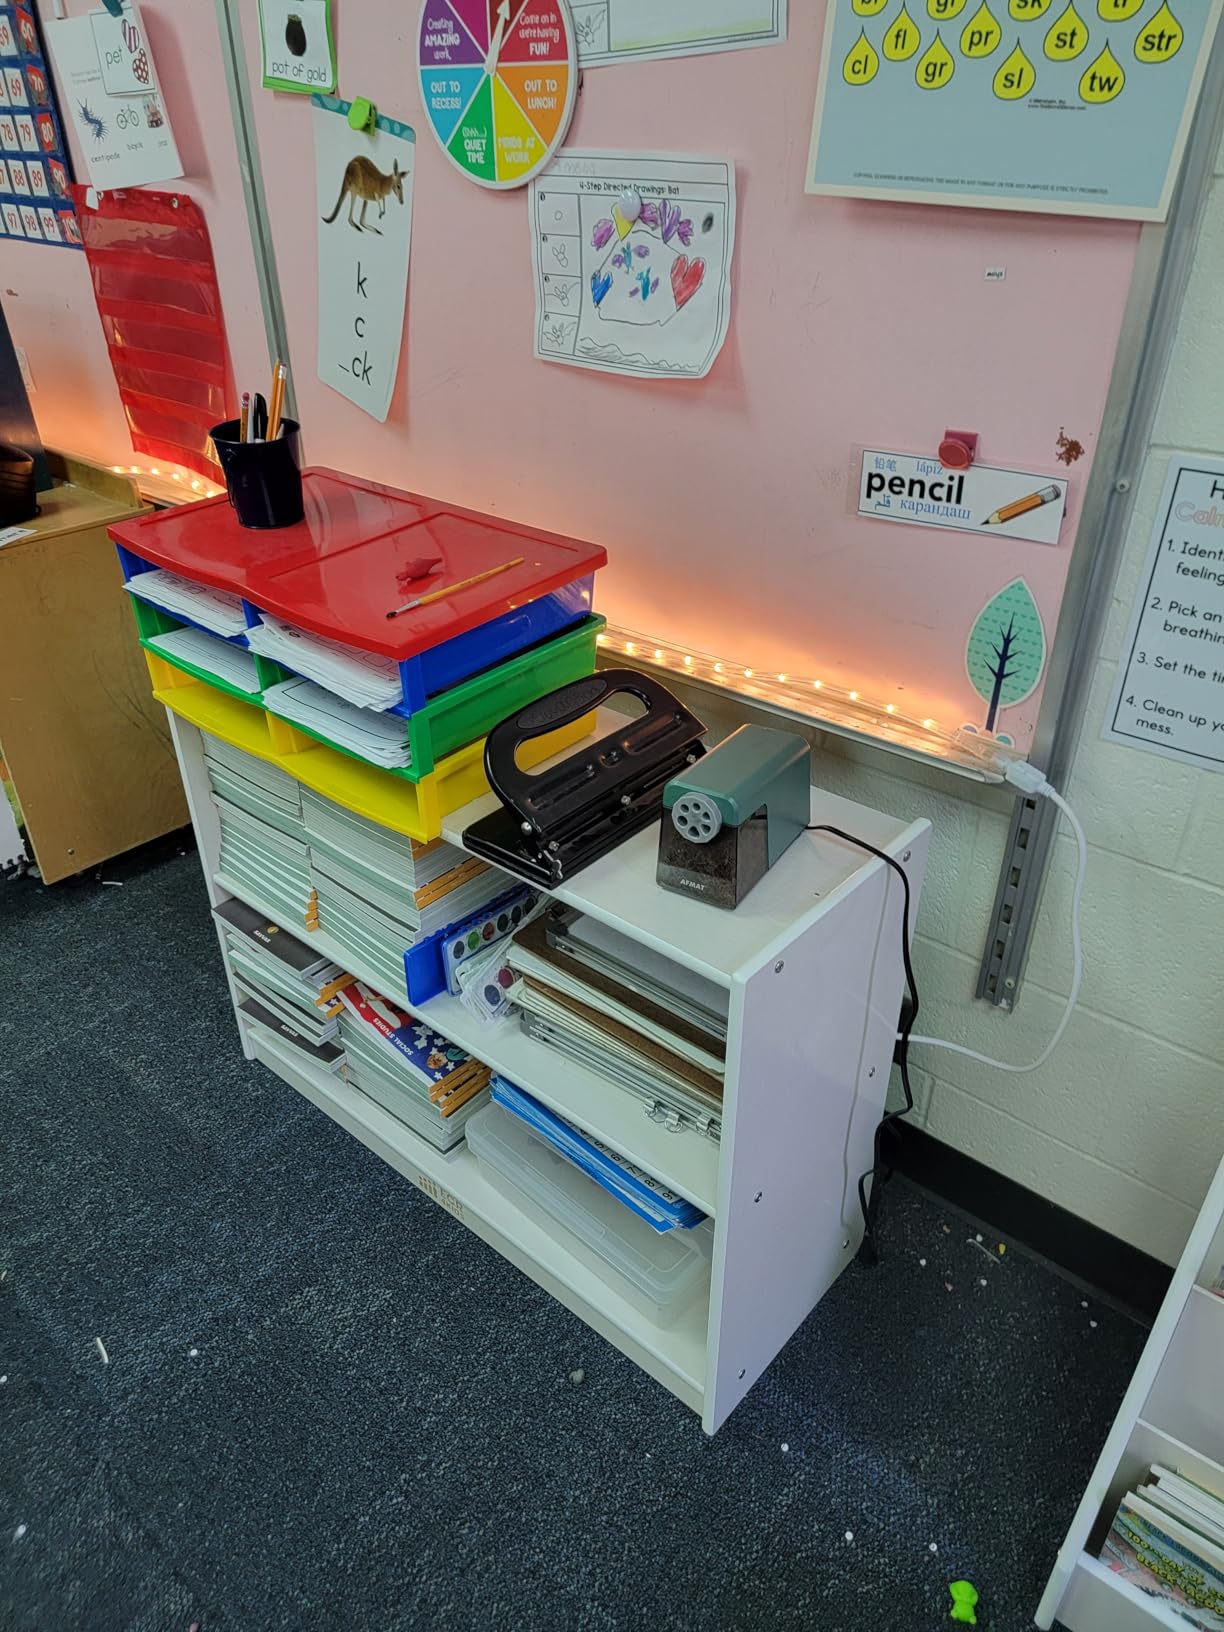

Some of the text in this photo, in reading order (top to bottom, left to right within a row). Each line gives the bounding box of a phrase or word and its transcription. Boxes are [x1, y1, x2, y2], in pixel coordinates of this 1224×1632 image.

[427, 18, 454, 33] Creating
[520, 12, 557, 25] Come on in
[424, 33, 460, 47] AMAZING
[537, 26, 559, 43] having
[894, 29, 907, 50] fl
[968, 30, 994, 52] pr
[1055, 27, 1078, 49] st
[1142, 29, 1177, 52] str
[106, 47, 123, 70] pet
[529, 41, 549, 56] FUN!
[272, 61, 327, 83] pot of gold
[851, 55, 868, 75] cl
[924, 61, 947, 83] gr
[11, 78, 21, 97] 69
[431, 81, 460, 93] OUT TO
[524, 80, 557, 92] OUT TO
[1003, 68, 1024, 89] sl
[1089, 70, 1118, 92] tw
[528, 96, 557, 109] LUNCH!
[1, 121, 54, 143] 78 79 80
[464, 139, 486, 152] QUIET
[467, 152, 485, 164] TIME
[13, 169, 25, 186] 88
[32, 170, 43, 187] 89
[580, 181, 601, 191] 4-Step
[668, 186, 679, 195] Bat
[7, 212, 18, 229] 97
[25, 214, 37, 232] 98
[43, 216, 55, 233] 99
[356, 261, 368, 299] k
[354, 316, 365, 338] c
[875, 457, 896, 472] 铅笔
[916, 460, 943, 476] lápiz
[866, 472, 965, 505] pencil
[900, 499, 971, 520] карандаш
[1168, 539, 1175, 552] 1.
[1150, 597, 1222, 623] 2. Pick an
[1137, 651, 1224, 684] 3. Set the ti
[1125, 695, 1137, 708] 4.
[1143, 699, 1184, 720] Clean
[1188, 714, 1207, 728] up
[1136, 718, 1174, 736] mess.
[680, 878, 705, 891] AFMAT
[373, 1017, 414, 1056] SOCIAL STUDIES
[1136, 1552, 1177, 1584] BLACK
[1162, 1555, 1184, 1572] DAY
